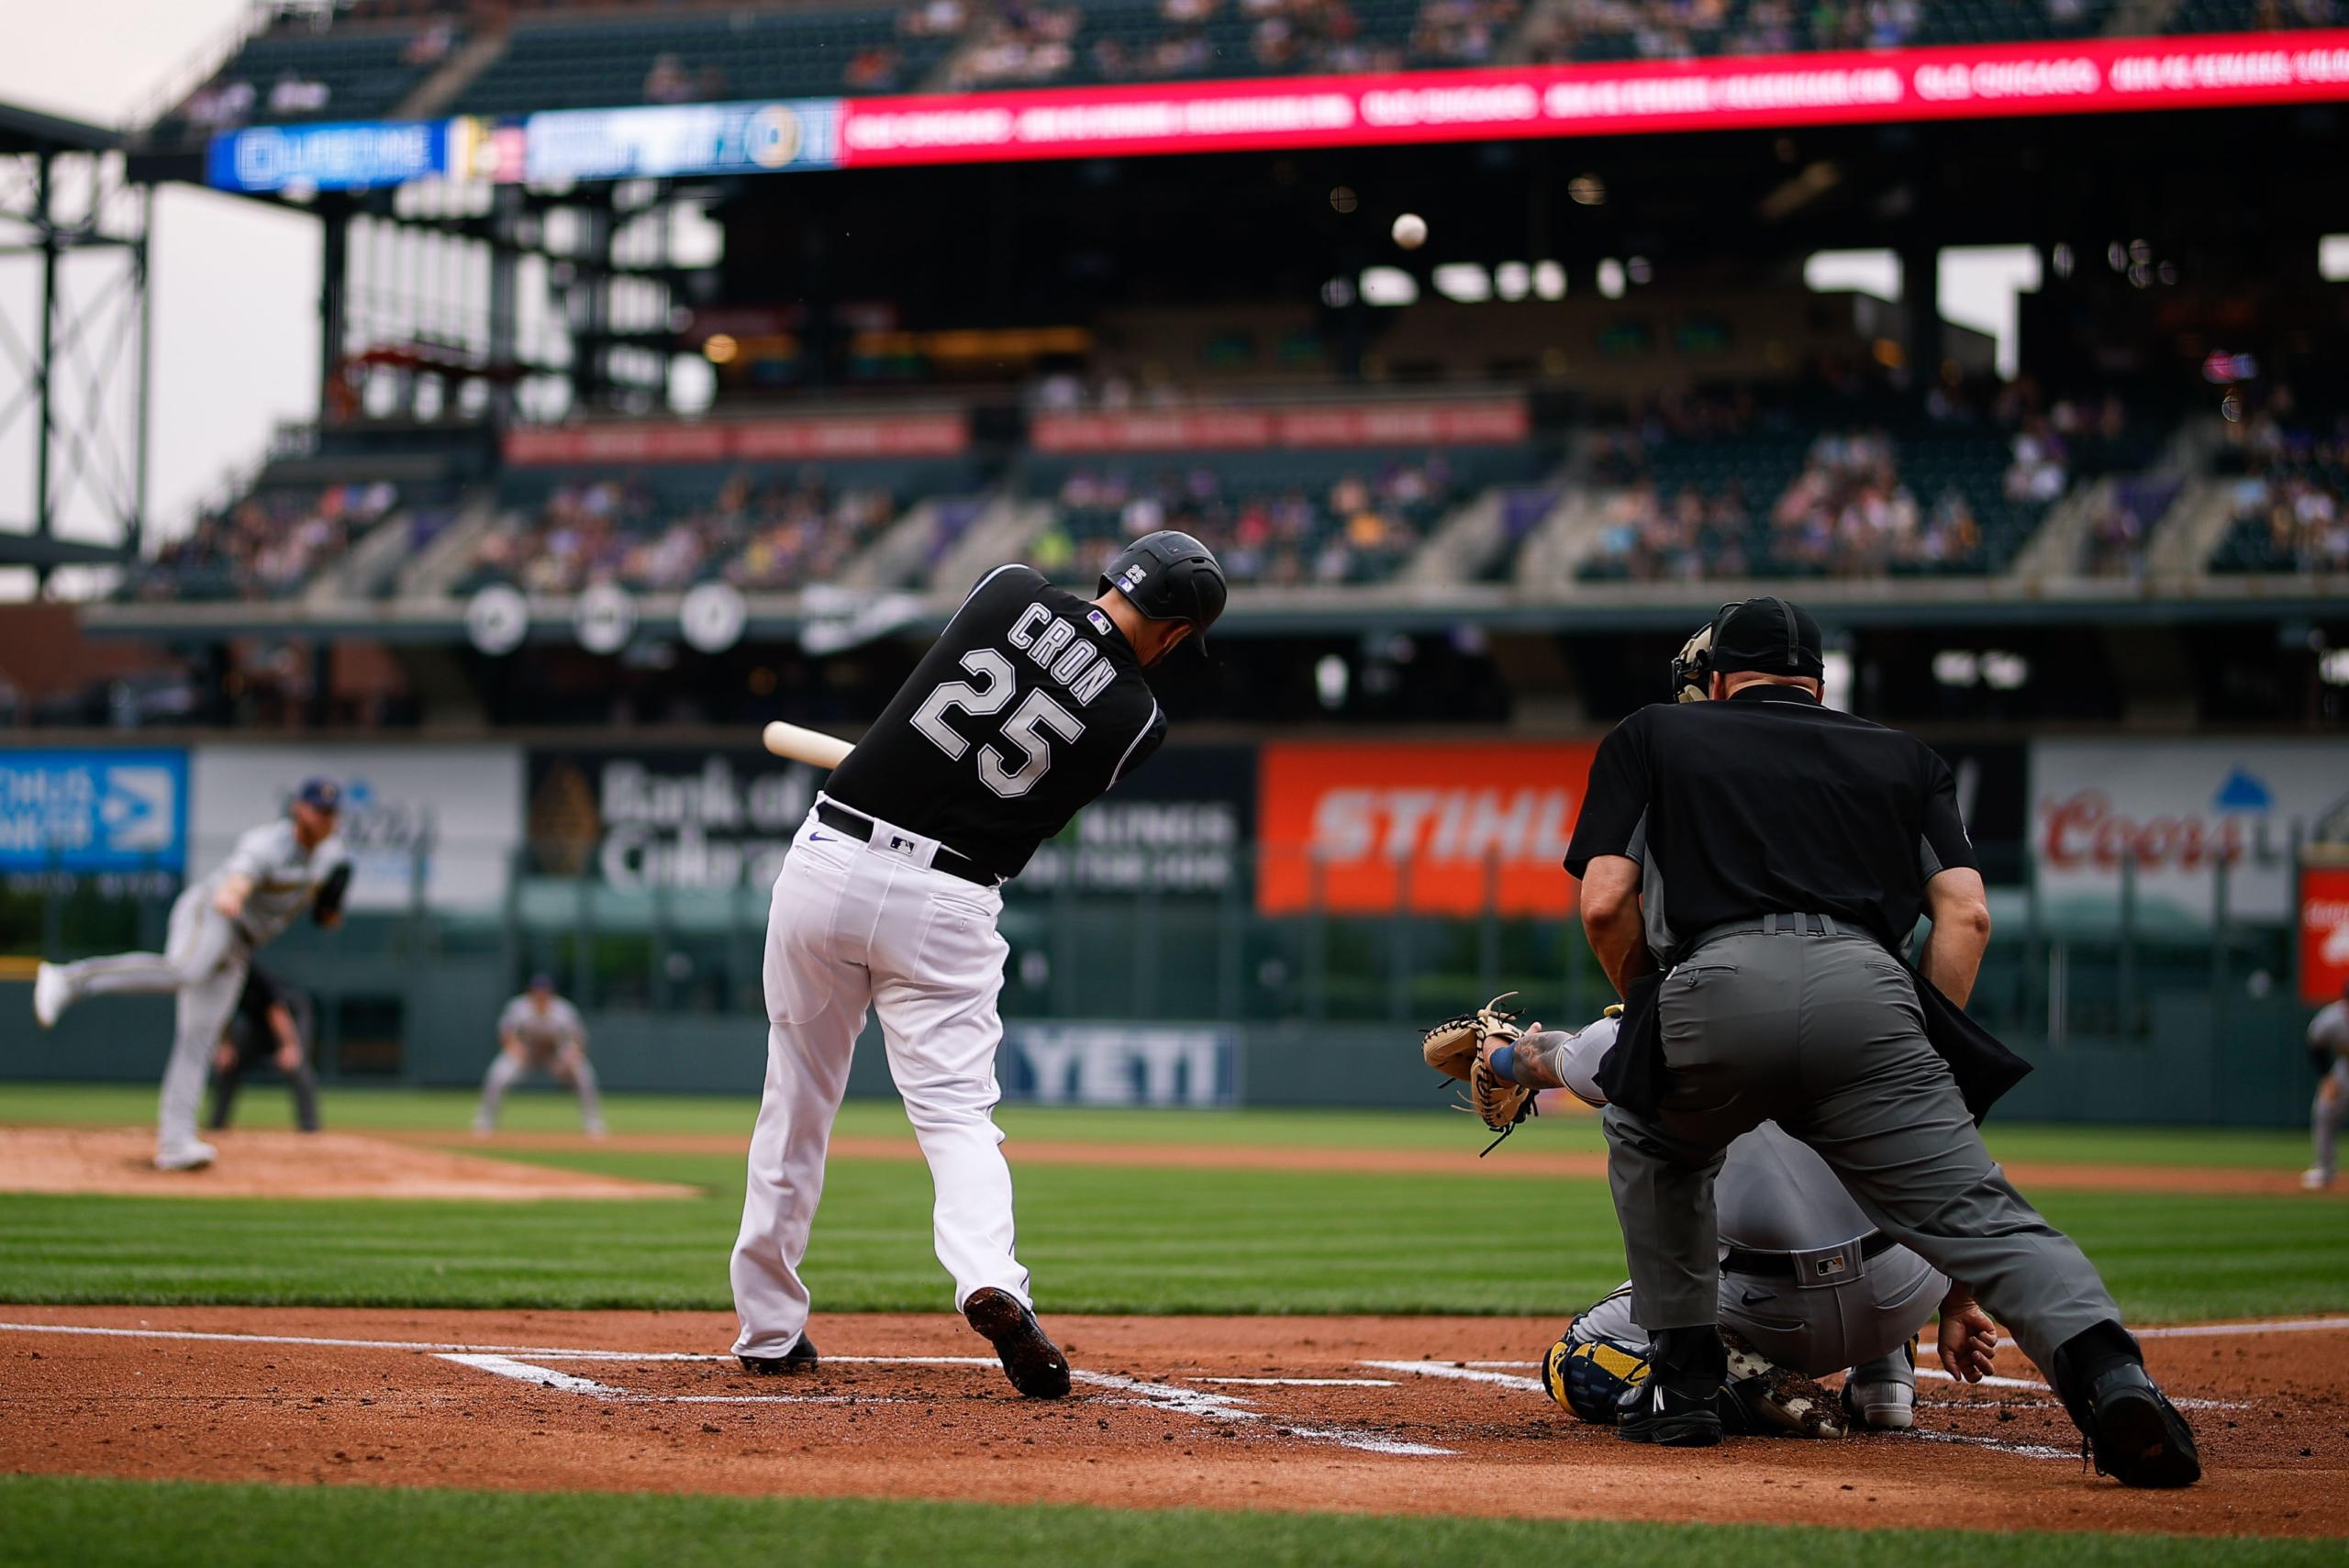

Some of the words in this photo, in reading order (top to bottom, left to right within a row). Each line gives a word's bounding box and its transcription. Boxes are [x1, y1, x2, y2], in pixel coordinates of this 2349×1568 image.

[1125, 564, 1147, 584] 25
[1007, 602, 1118, 706] CRON
[909, 648, 1087, 798] 25
[602, 757, 743, 826] Bank
[748, 762, 815, 826] of
[1312, 786, 1573, 862] STIHL
[2039, 788, 2244, 873] Coors
[1021, 1025, 1219, 1105] YETI
